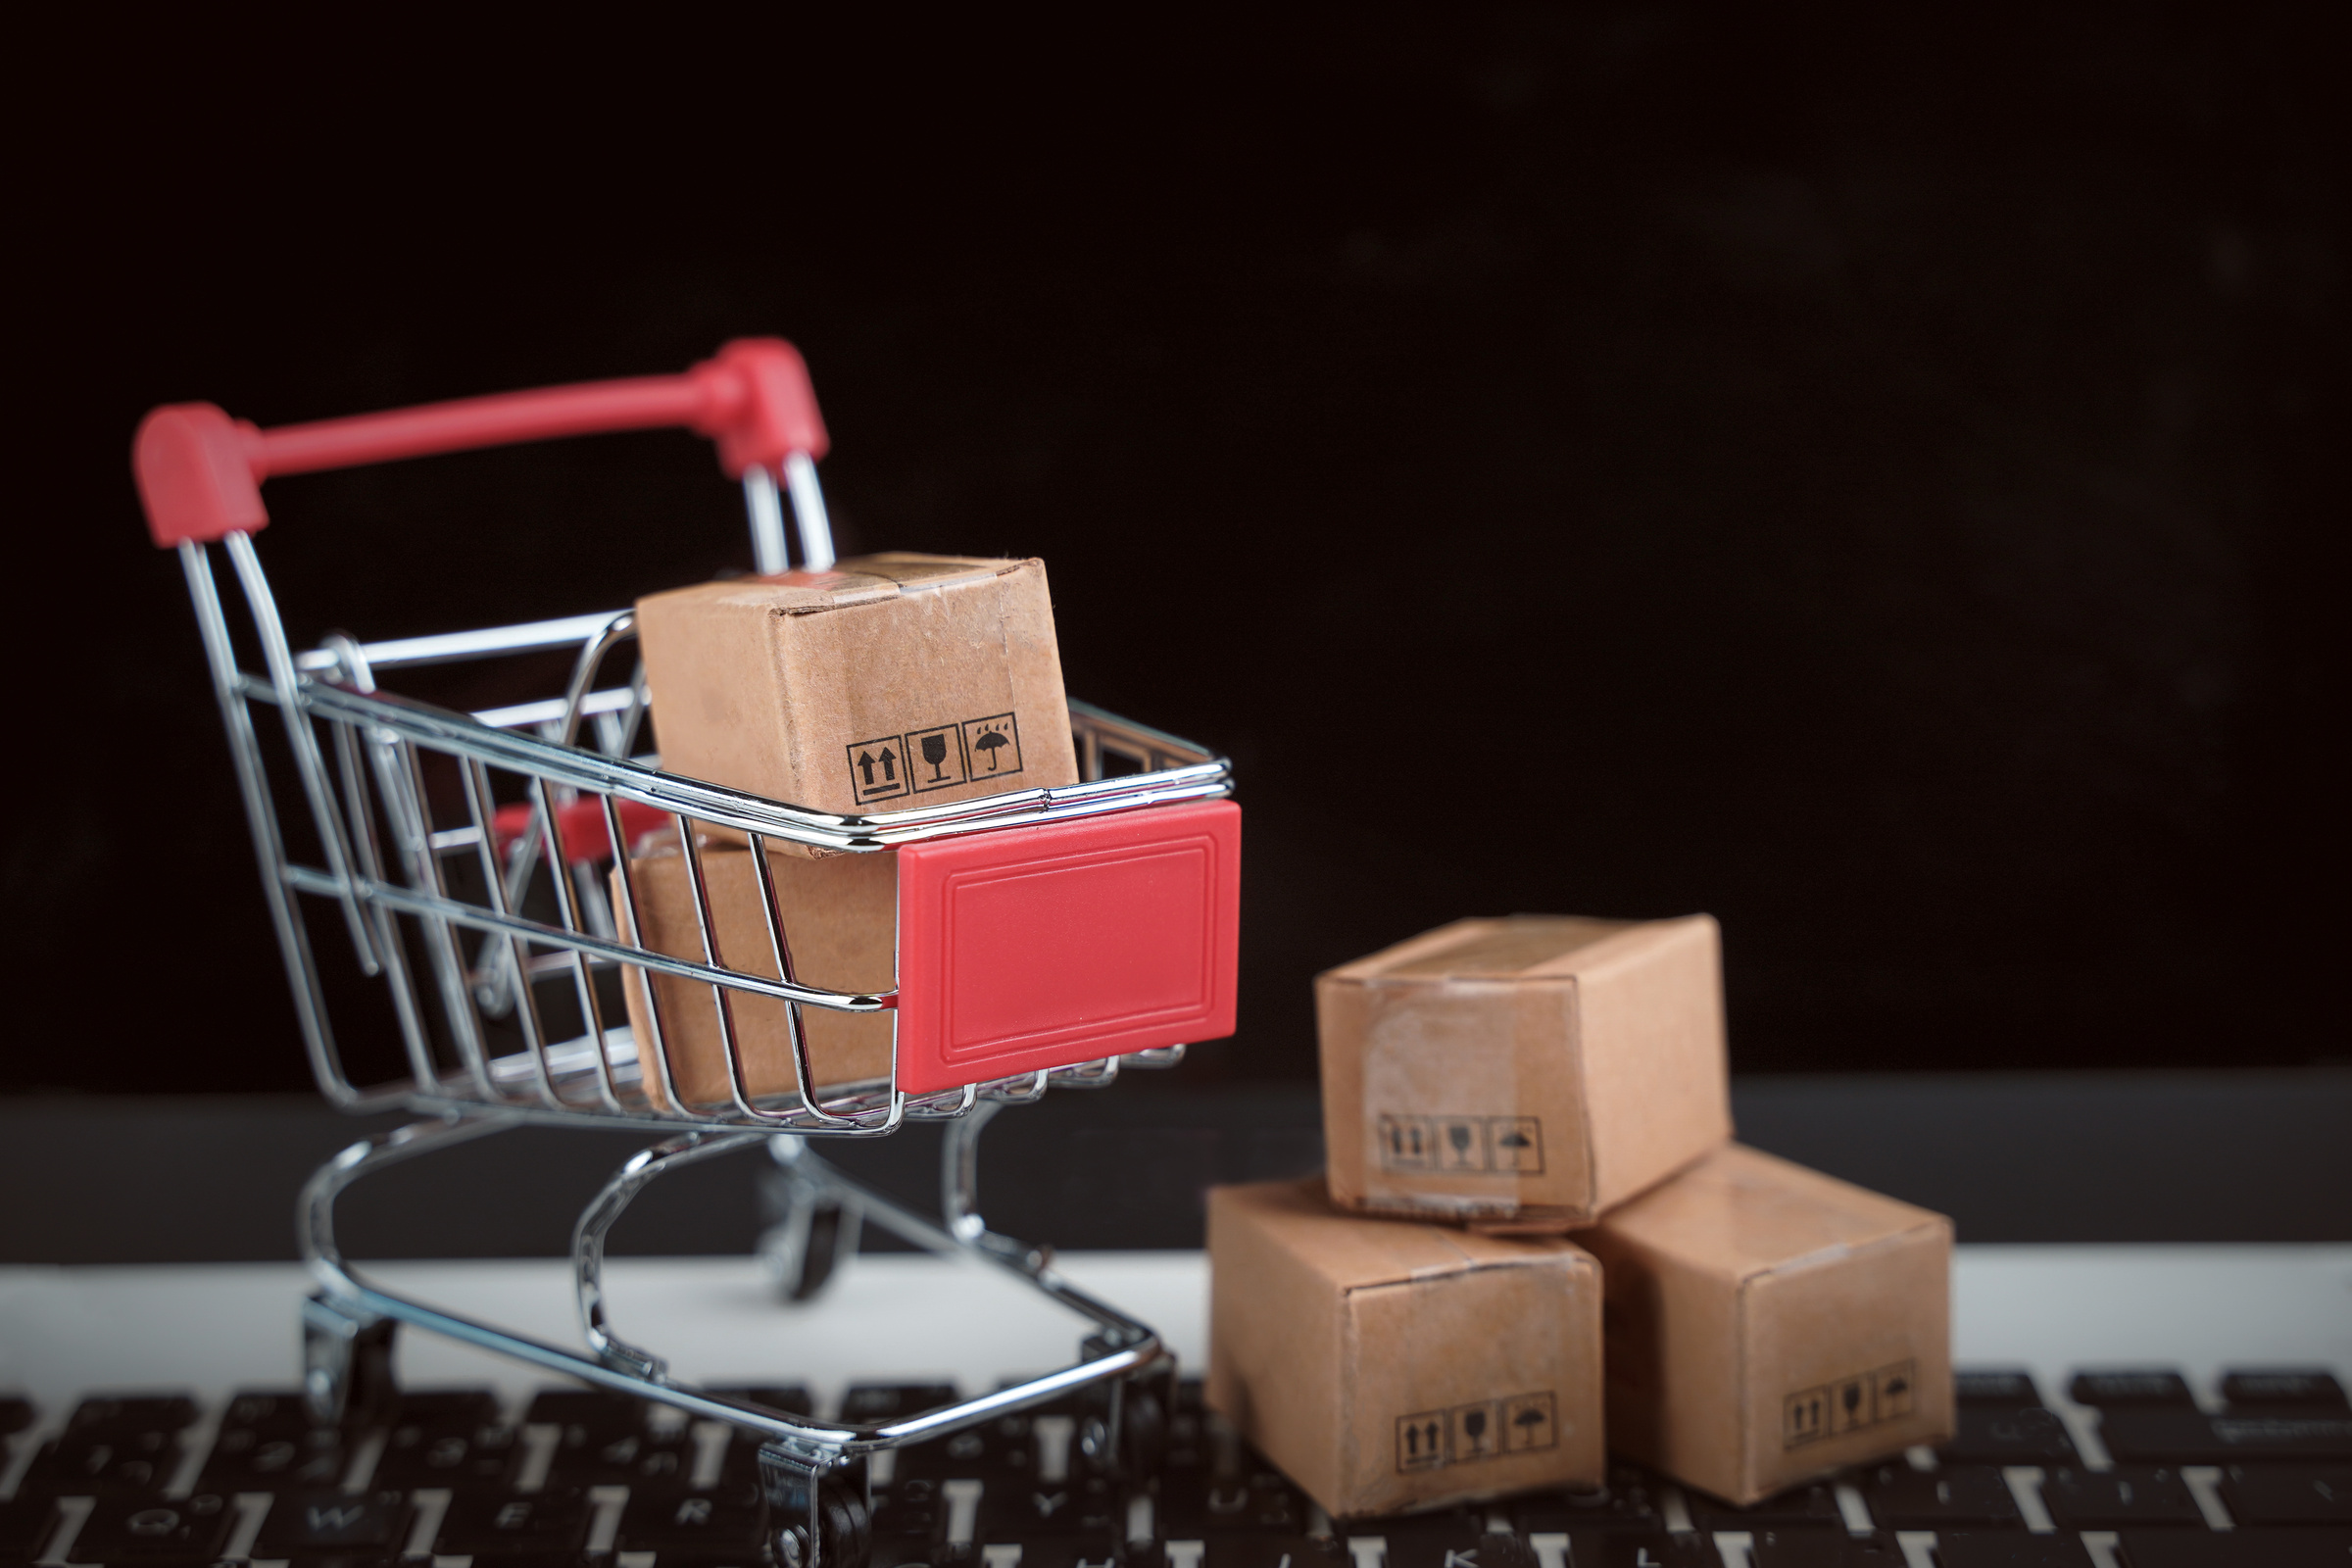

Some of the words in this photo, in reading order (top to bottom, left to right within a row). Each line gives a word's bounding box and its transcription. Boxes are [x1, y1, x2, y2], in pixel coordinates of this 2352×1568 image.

[307, 1504, 365, 1531] W
[495, 1501, 533, 1530] E
[675, 1498, 713, 1526] R
[1032, 1491, 1068, 1518] Y
[1445, 1548, 1479, 1568] K
